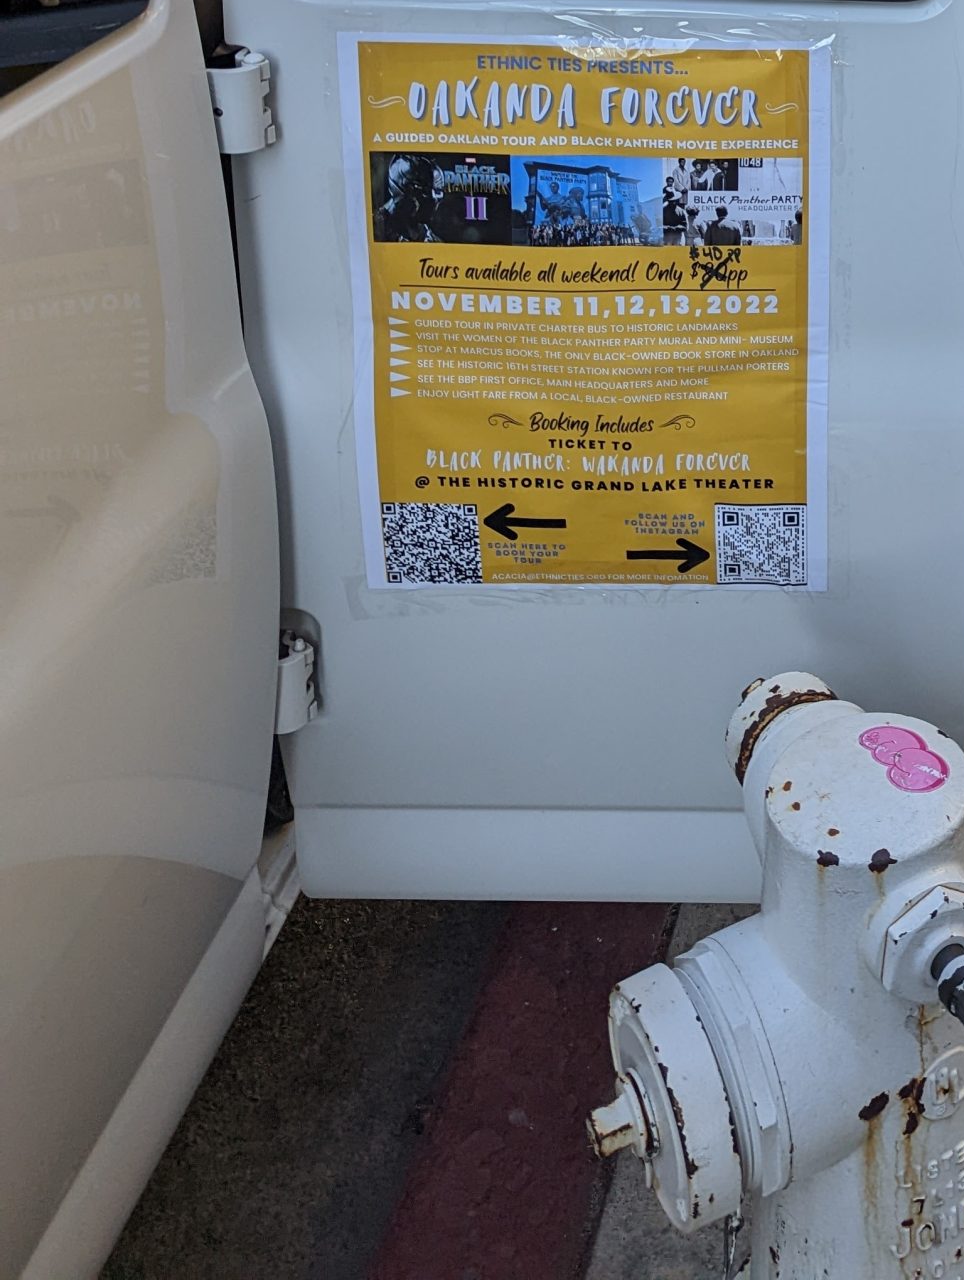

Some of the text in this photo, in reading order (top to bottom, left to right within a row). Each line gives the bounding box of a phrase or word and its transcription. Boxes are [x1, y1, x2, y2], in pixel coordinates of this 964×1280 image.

[477, 55, 689, 74] ETHNIC TIES PRESENTS...
[408, 76, 762, 128] OAKANDA FOREVER
[373, 133, 799, 150] A GUIDED OAKLAND TOUR AND BLACK PANTHER MOVIE EXPERIENCE
[455, 165, 496, 175] BLACK
[740, 158, 761, 167] 1048
[444, 171, 511, 195] PANTHER
[694, 196, 803, 205] BLACK Panther PARTY
[419, 257, 459, 280] Tours
[464, 261, 532, 282] available
[537, 262, 557, 283] all
[561, 261, 640, 283] weekend!
[645, 261, 683, 290] Only
[391, 291, 562, 317] NOVEMBER
[414, 319, 738, 334] GUIDED TOUR IN PRIVATE CHARTER BUS TO HISTORIC LANDMARKS
[416, 332, 440, 340] VISIT
[442, 333, 460, 342] THE
[463, 334, 503, 343] WOMEN
[505, 335, 518, 344] OF
[521, 336, 538, 345] THE
[541, 337, 572, 346] BLACK
[575, 338, 621, 347] PANTHER
[624, 337, 655, 347] PARTY
[658, 336, 693, 346] MURAL
[695, 336, 718, 345] AND
[750, 335, 793, 344] MUSEUM
[417, 345, 799, 361] STOP AT MARCUS BOOKS, THE ONLY BLACK-OWNED BOOK STORE IN OAKLAND
[417, 359, 790, 375] SEE THE HISTORIC 16TH STREET STATION KNOWN FOR THE PULLMAN PORTERS
[417, 374, 709, 390] SEE THE BBP FIRST OFFICE, MAIN HEADQUARTERS AND MORE
[417, 390, 450, 399] ENJOY
[452, 390, 480, 399] LIGHT
[482, 391, 507, 400] FARE
[509, 391, 538, 400] FROM
[540, 391, 548, 400] A
[585, 393, 662, 404] BLACK-OWNED
[664, 392, 729, 401] RESTAURANT
[529, 411, 655, 437] Booking Includes
[548, 439, 632, 451] TICKET TO
[426, 448, 751, 476] BLACK PANTHER: WAKANDA FOREVER
[415, 476, 775, 492] @ THE HISTORIC GRAND LAKE THEATER
[608, 573, 625, 581] FOR
